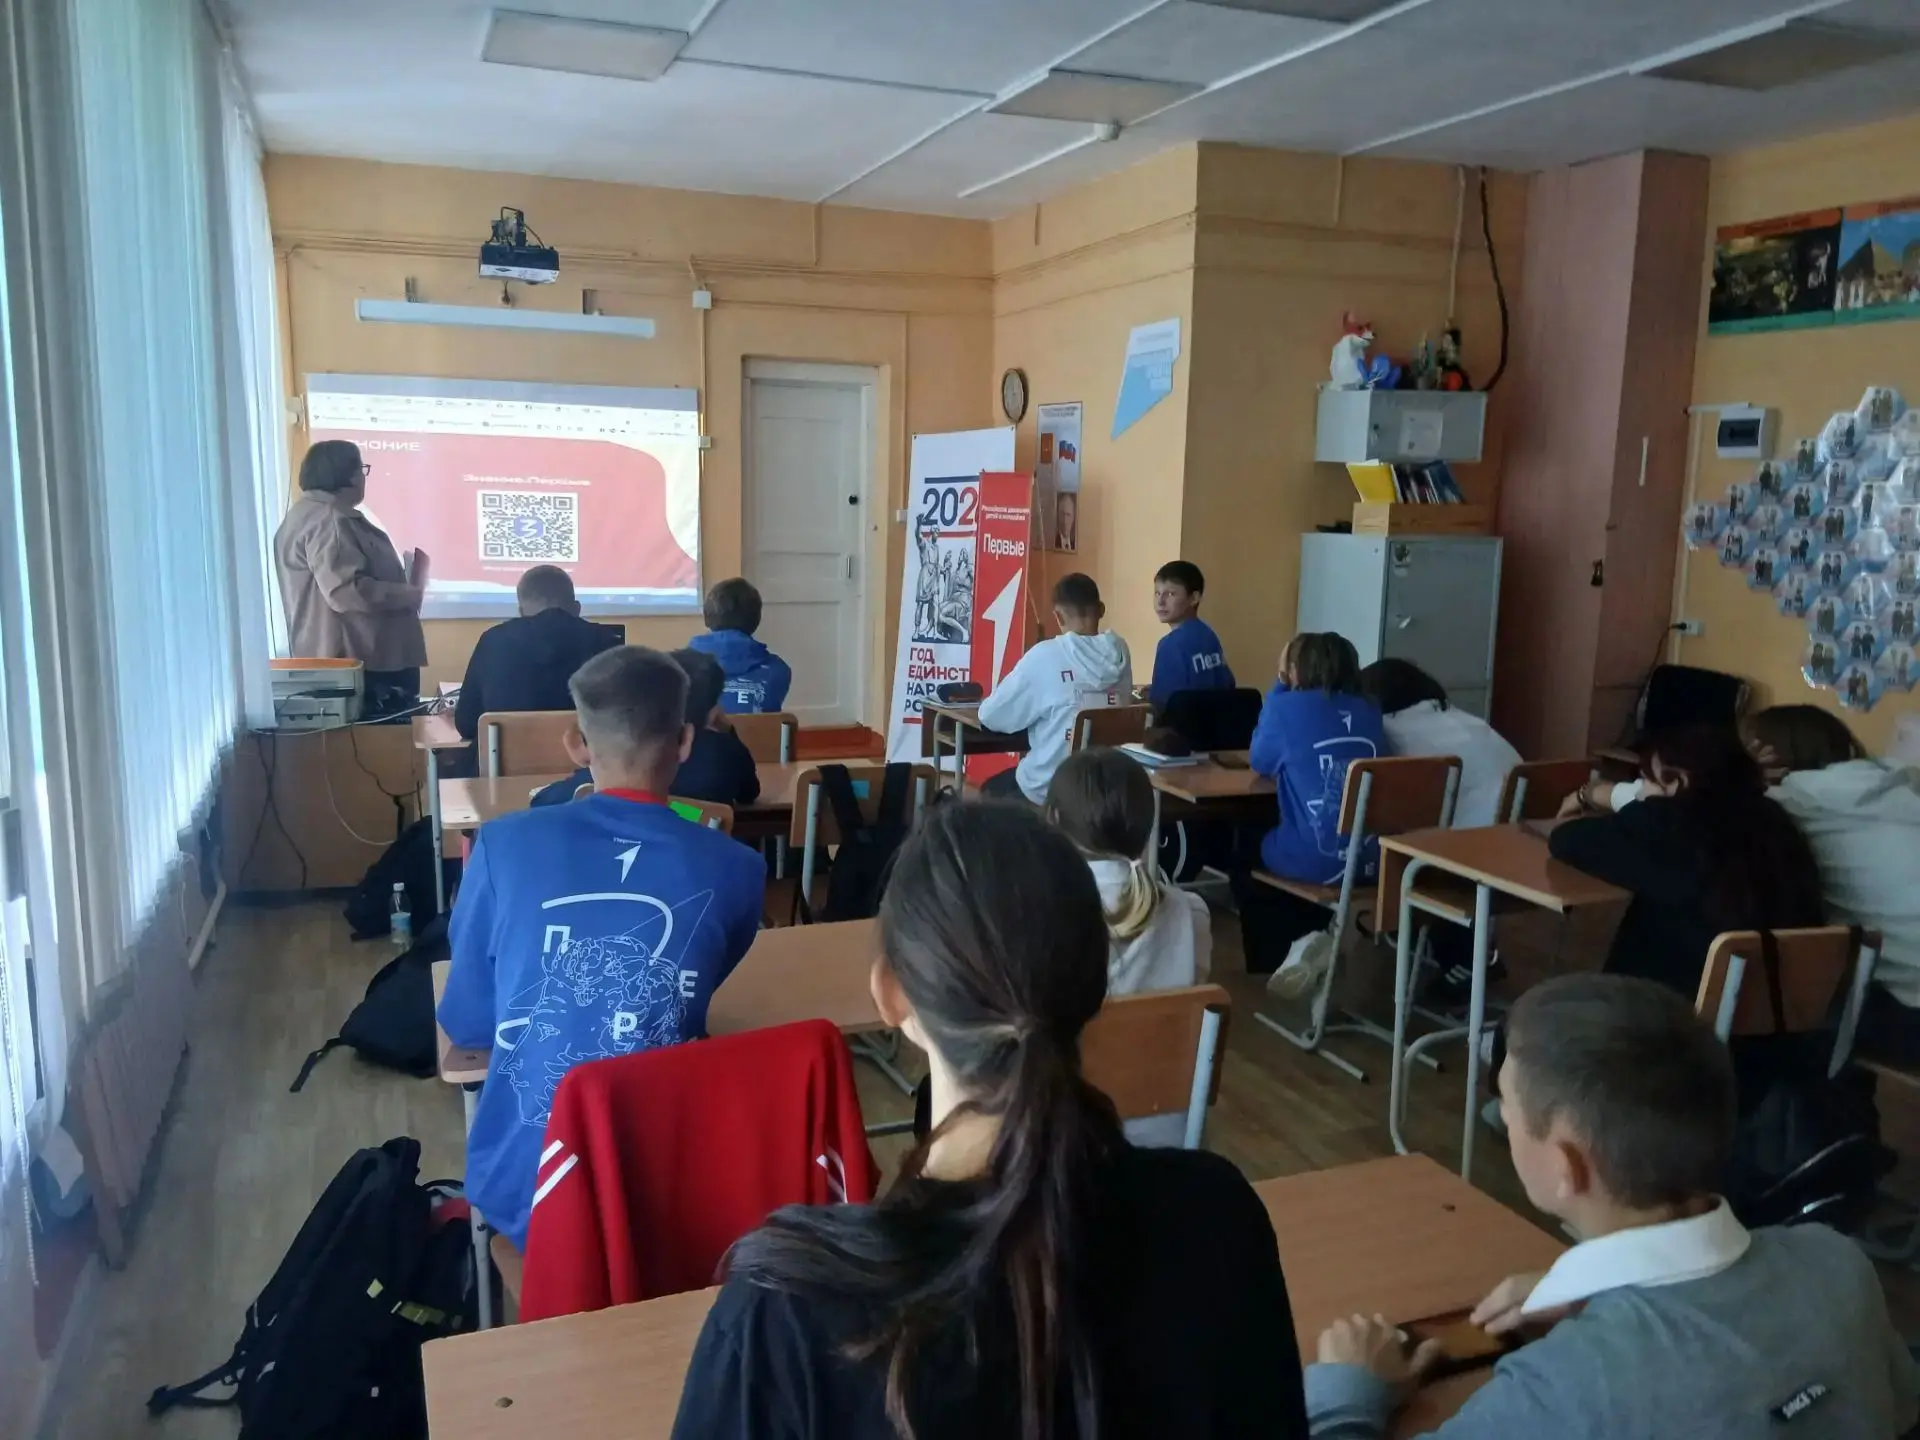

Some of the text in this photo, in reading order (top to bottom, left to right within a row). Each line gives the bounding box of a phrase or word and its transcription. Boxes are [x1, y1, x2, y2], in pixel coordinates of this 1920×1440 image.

[921, 486, 979, 526] 202
[984, 533, 1024, 560] Первые
[910, 647, 935, 664] ГОД
[909, 665, 969, 681] ЕДИНСТ
